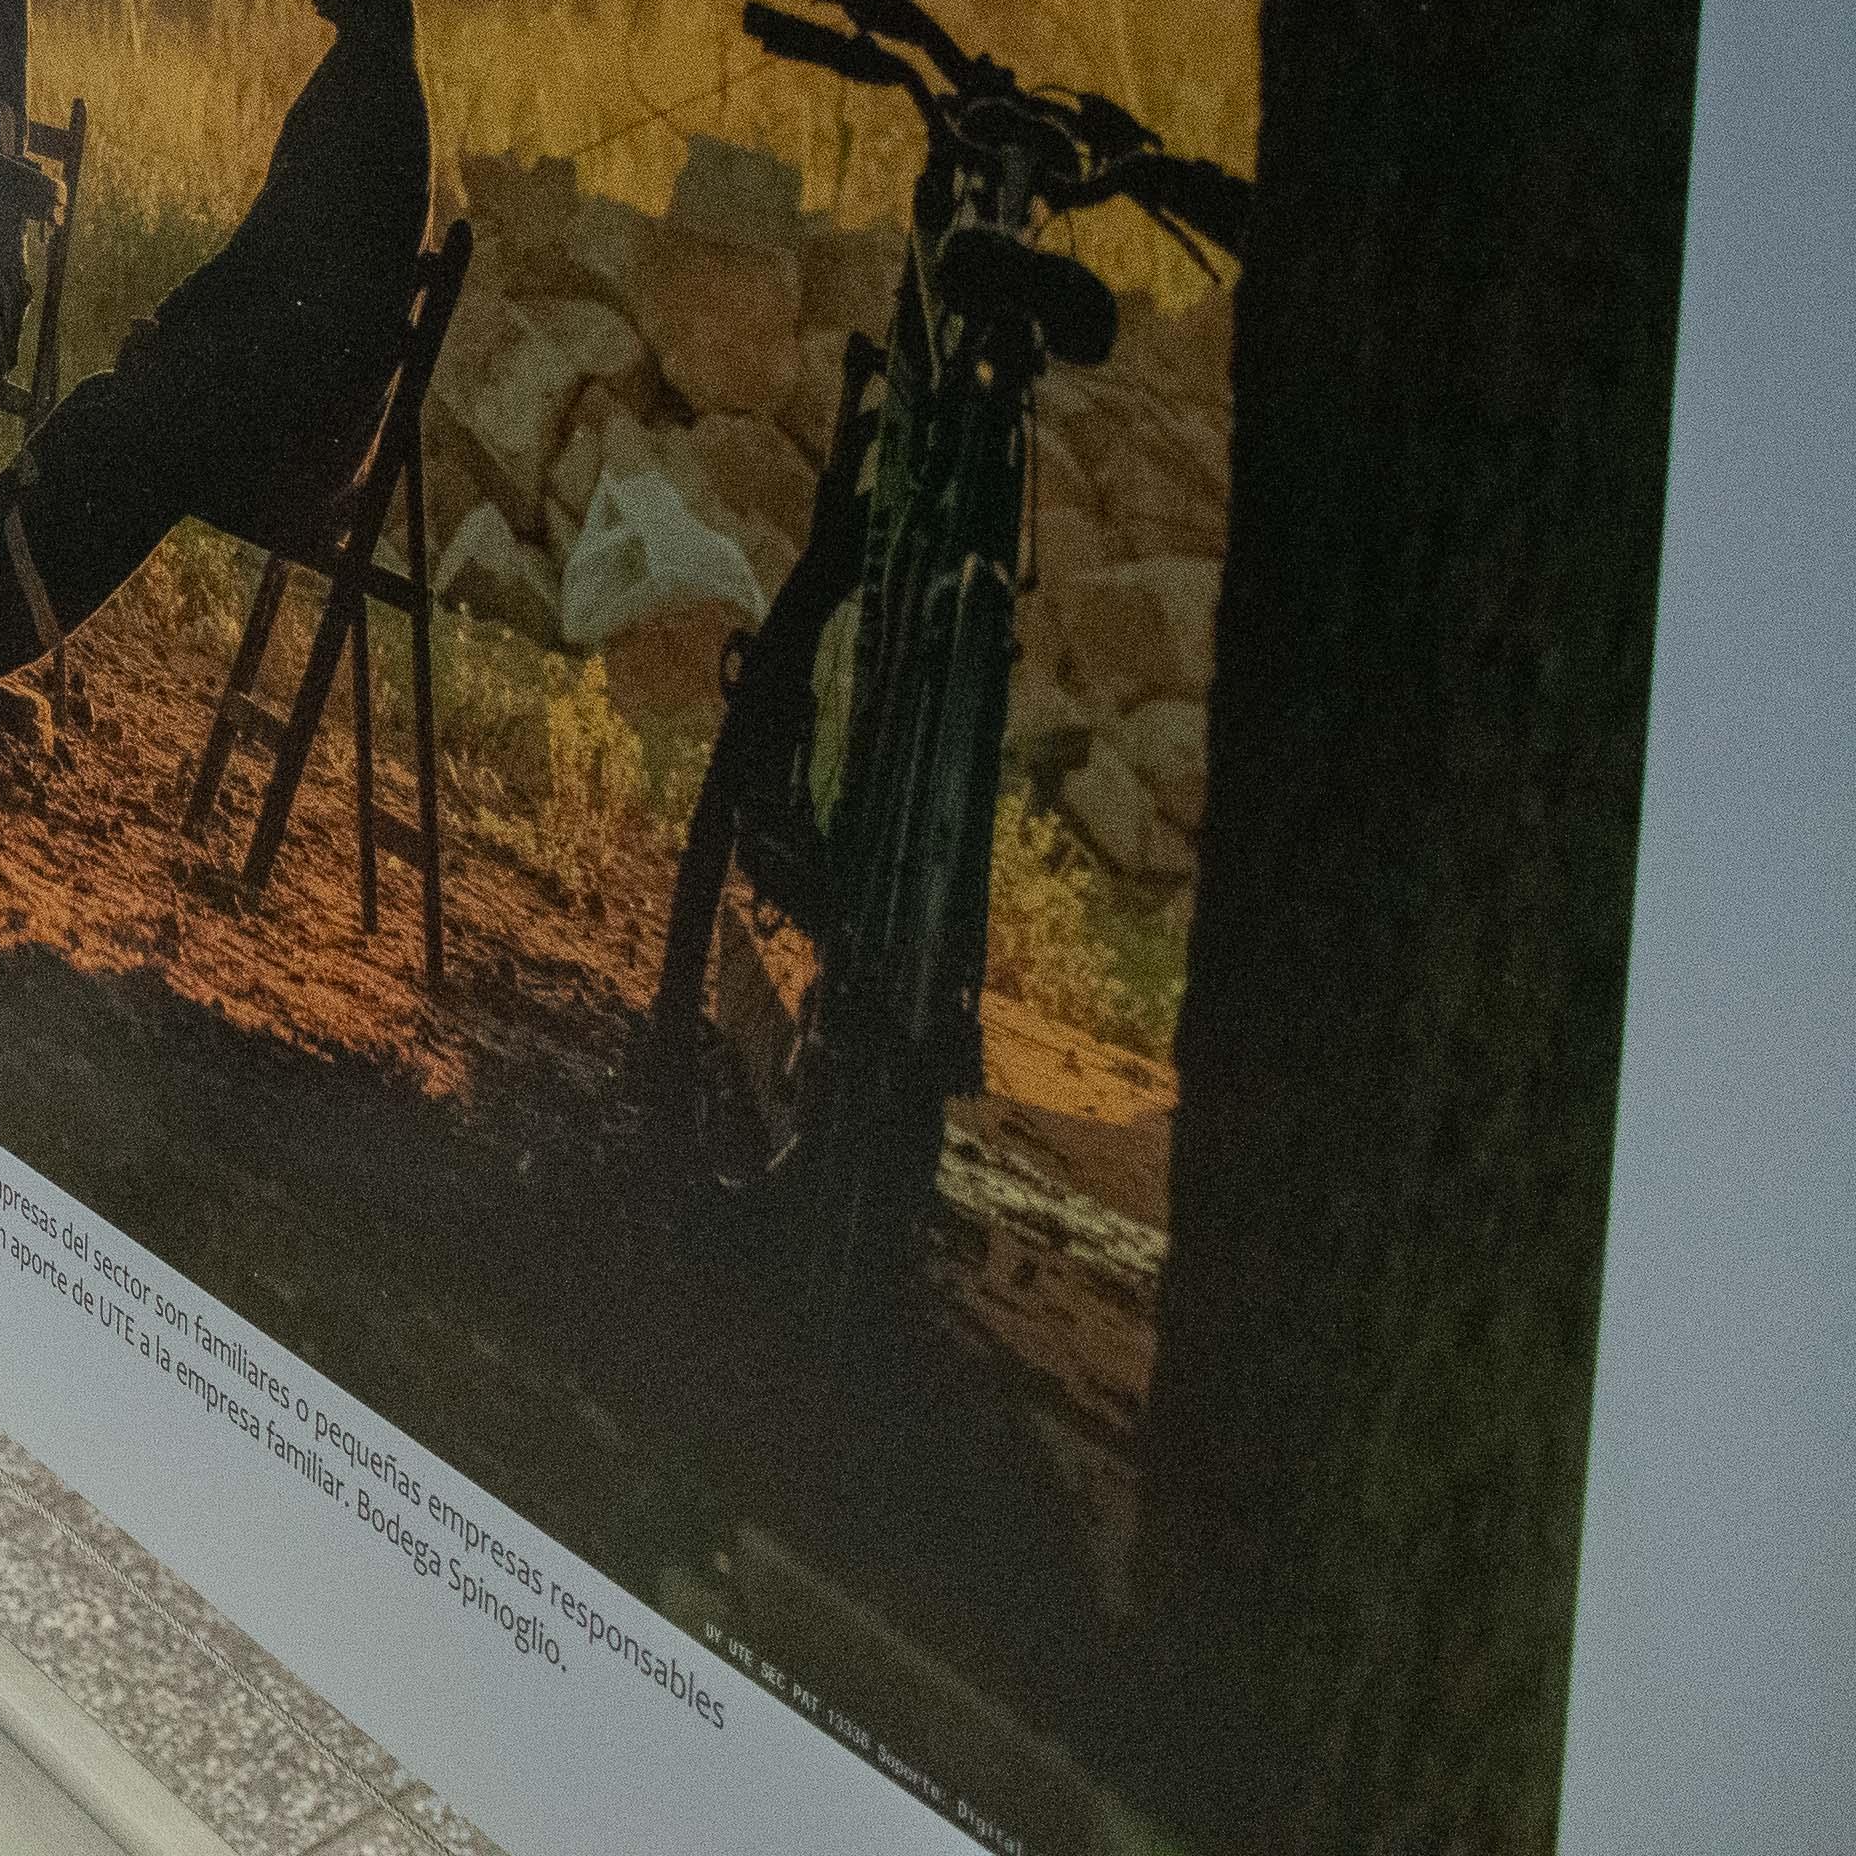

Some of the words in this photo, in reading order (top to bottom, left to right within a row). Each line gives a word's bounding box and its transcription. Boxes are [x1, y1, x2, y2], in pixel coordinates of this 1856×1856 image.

[11, 1235, 67, 1293] aporte
[72, 1274, 94, 1315] de
[100, 1296, 135, 1345] UTE
[140, 1334, 150, 1357] a
[156, 1336, 171, 1373] la
[177, 1359, 260, 1440] empresa
[266, 1421, 349, 1507] familiar.
[358, 1487, 441, 1577] Bodega
[447, 1561, 567, 1672] Spinoglio.
[63, 1223, 89, 1262] del
[94, 1250, 151, 1304] sector
[156, 1293, 188, 1335] son
[194, 1315, 290, 1409] familiares
[296, 1398, 309, 1422] o
[315, 1409, 421, 1506] pequeñas
[428, 1494, 543, 1596] empresas
[551, 1582, 725, 1730] responsables
[728, 1638, 753, 1668] UTE
[760, 1661, 786, 1690] SEC
[792, 1683, 819, 1712] PAT
